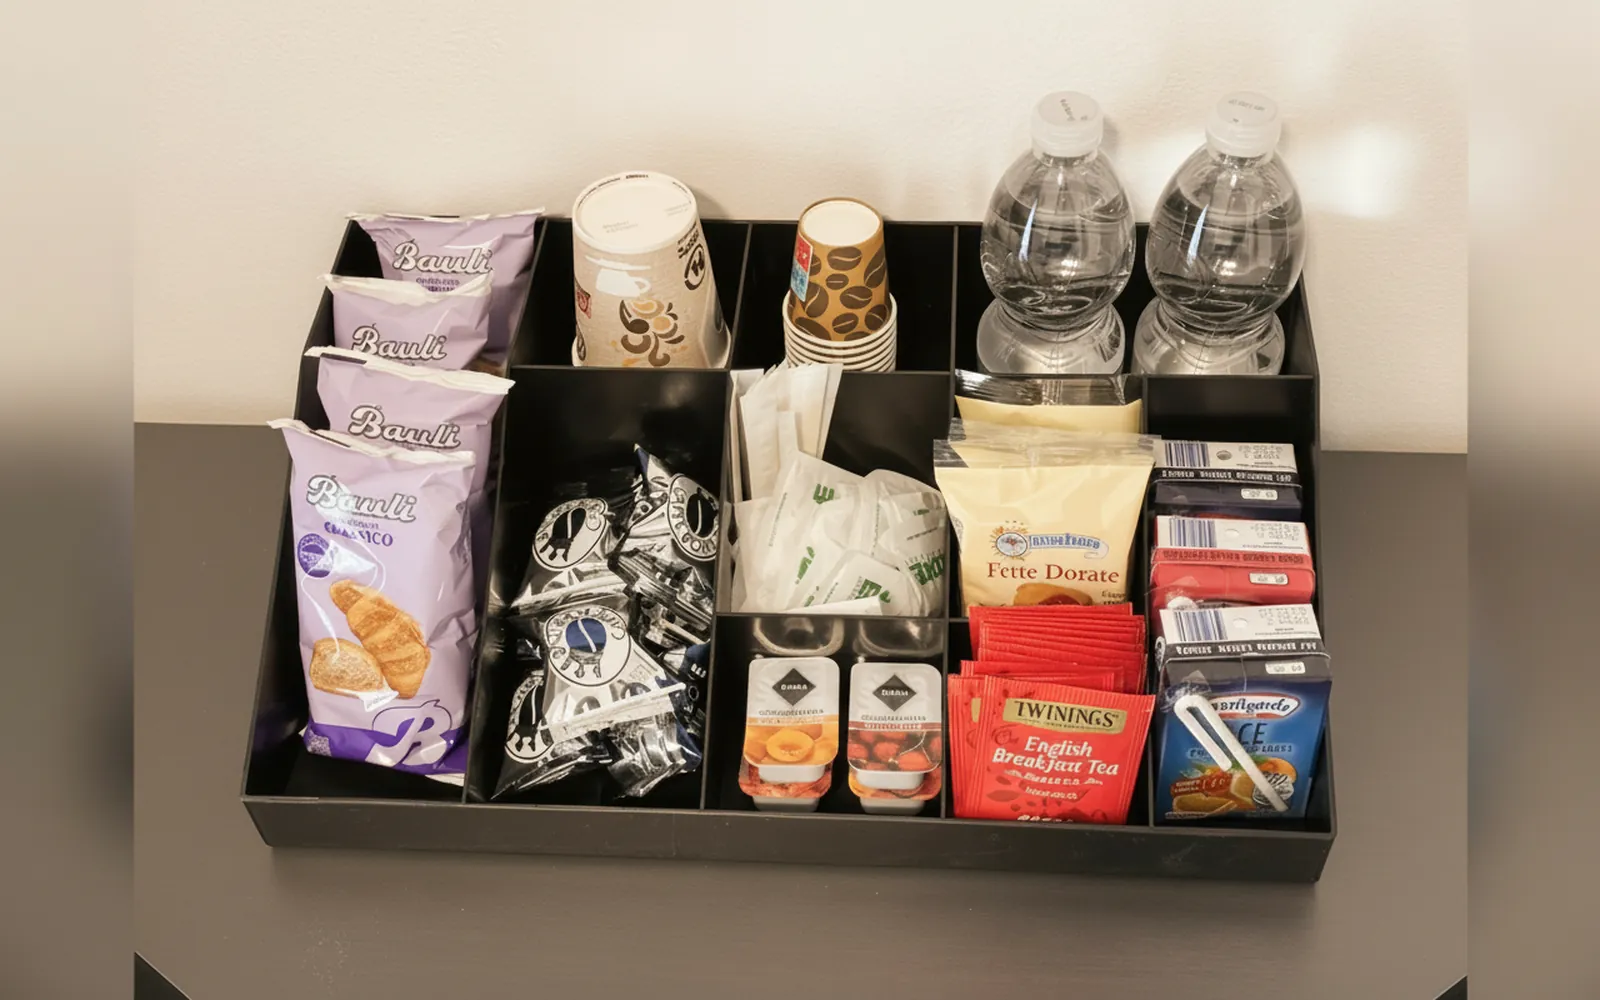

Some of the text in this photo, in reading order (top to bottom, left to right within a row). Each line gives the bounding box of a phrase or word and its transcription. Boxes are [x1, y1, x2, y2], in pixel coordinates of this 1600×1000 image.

[392, 238, 494, 275] Bauli
[350, 323, 448, 361] Bauli
[348, 405, 462, 450] Bauli
[306, 475, 418, 524] Bauli
[987, 562, 1121, 583] Fette Dorate
[1013, 700, 1114, 729] TWININGS
[1024, 735, 1093, 760] English
[1237, 721, 1268, 746] CE
[1088, 759, 1120, 776] Tea
